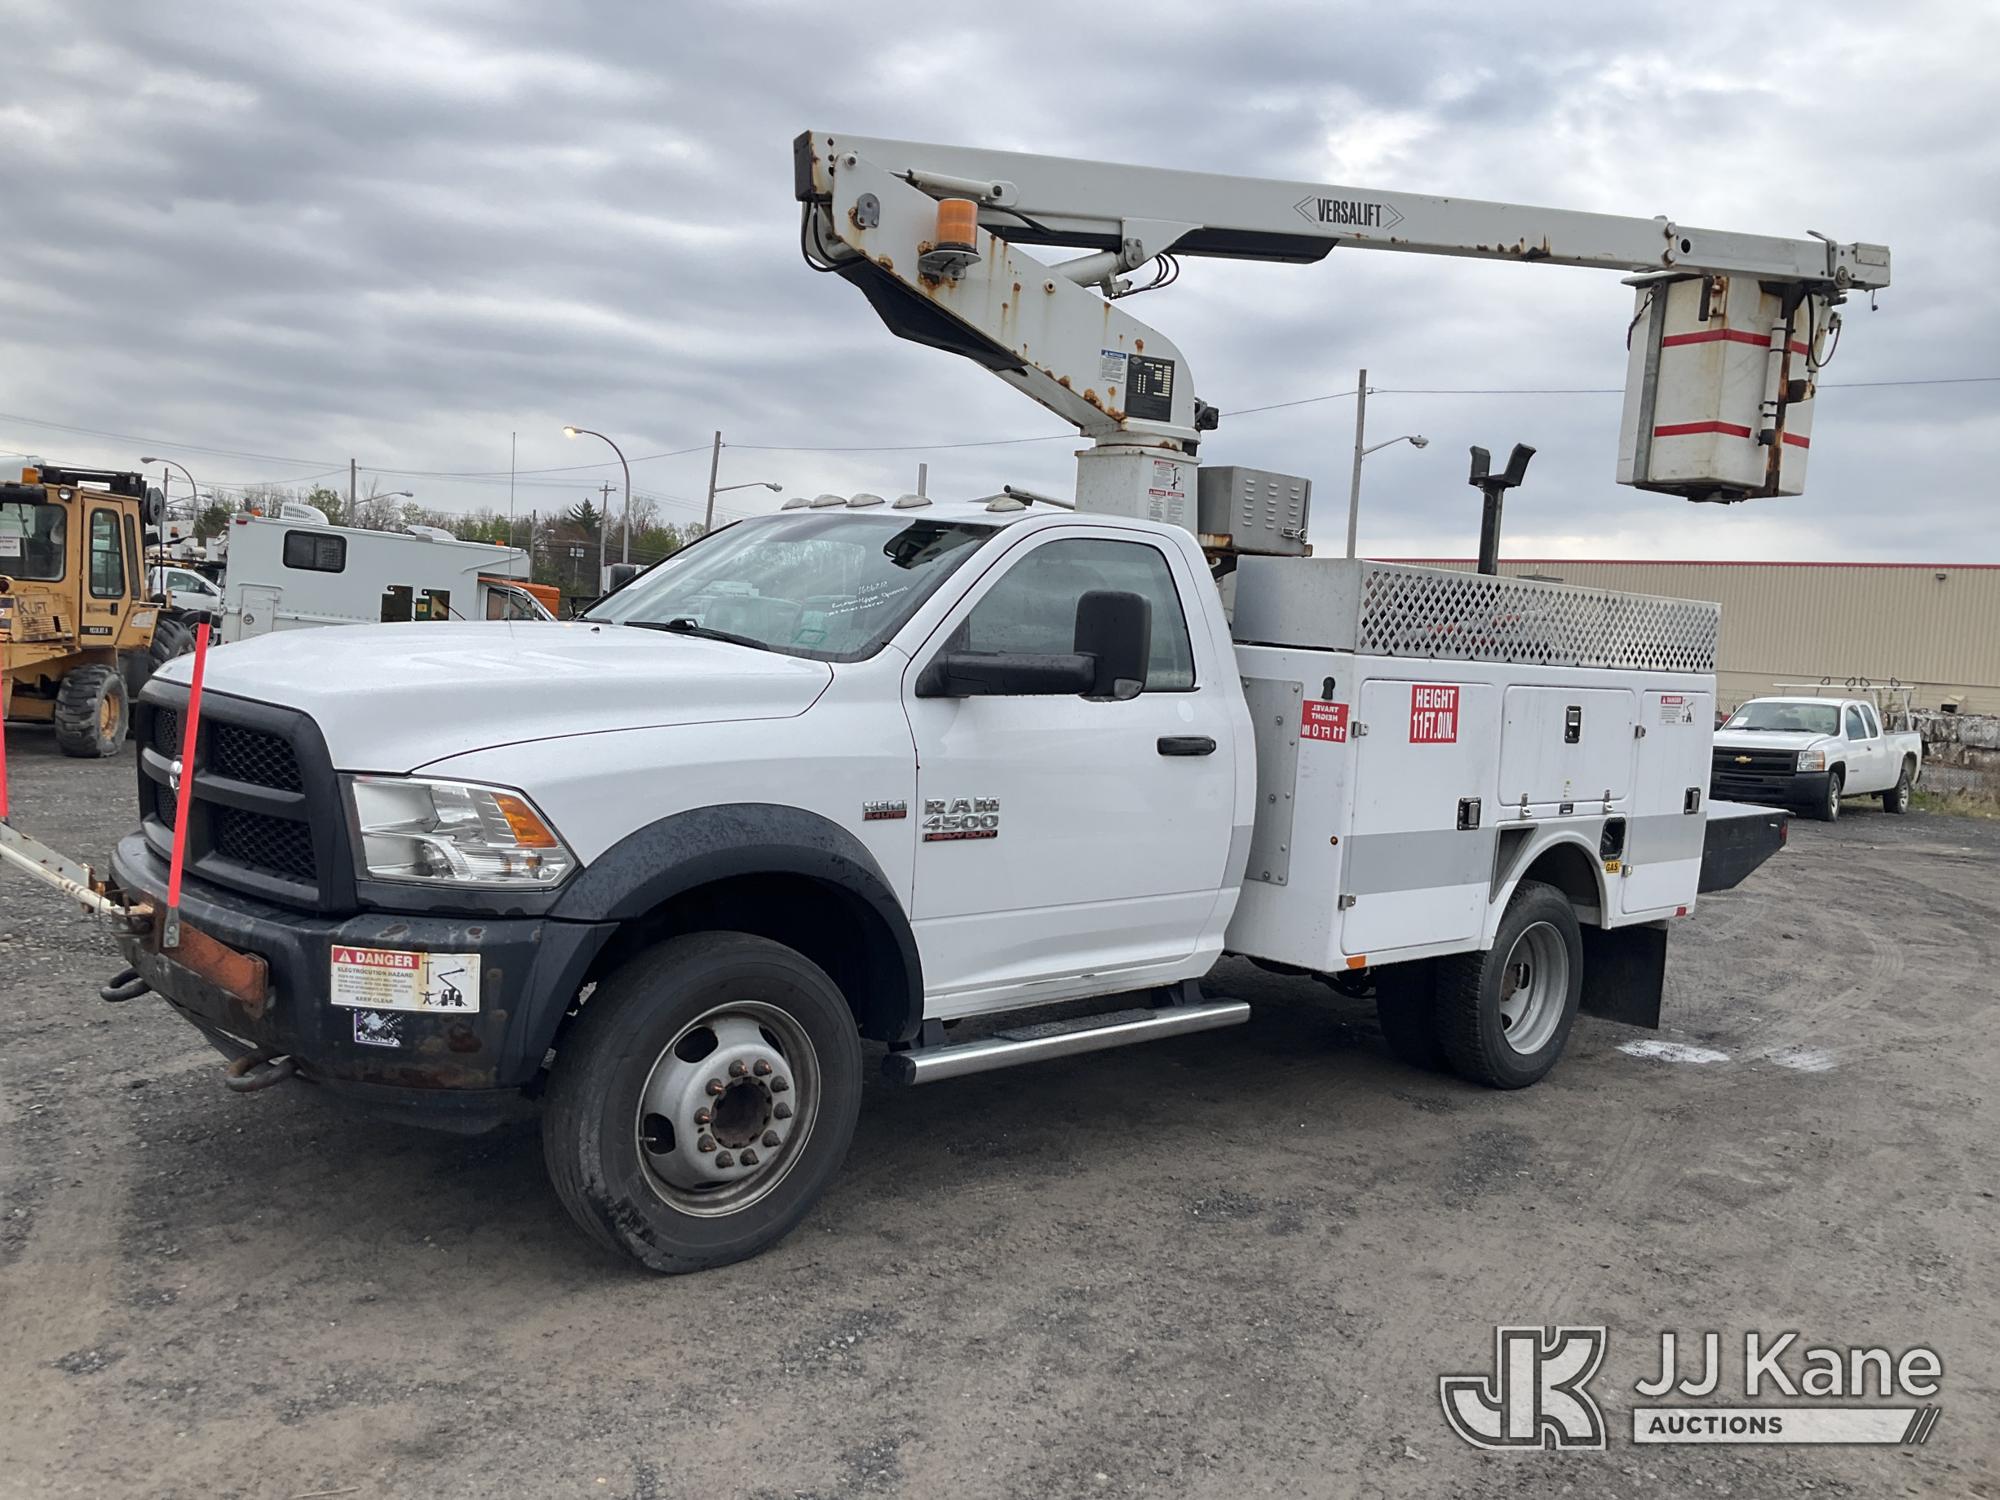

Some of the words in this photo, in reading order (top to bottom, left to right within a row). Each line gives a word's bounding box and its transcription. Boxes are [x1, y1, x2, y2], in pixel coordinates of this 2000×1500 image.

[1316, 198, 1382, 227] VERSALIFT
[1415, 688, 1456, 709] HEIGHT
[925, 797, 1000, 814] RAM
[922, 813, 999, 830] 4500
[965, 830, 996, 839] DUTY
[1605, 862, 1618, 872] GAS
[355, 952, 413, 968] DANGER
[337, 966, 387, 977] ELECTROCUTION
[388, 970, 414, 978] HAZARD
